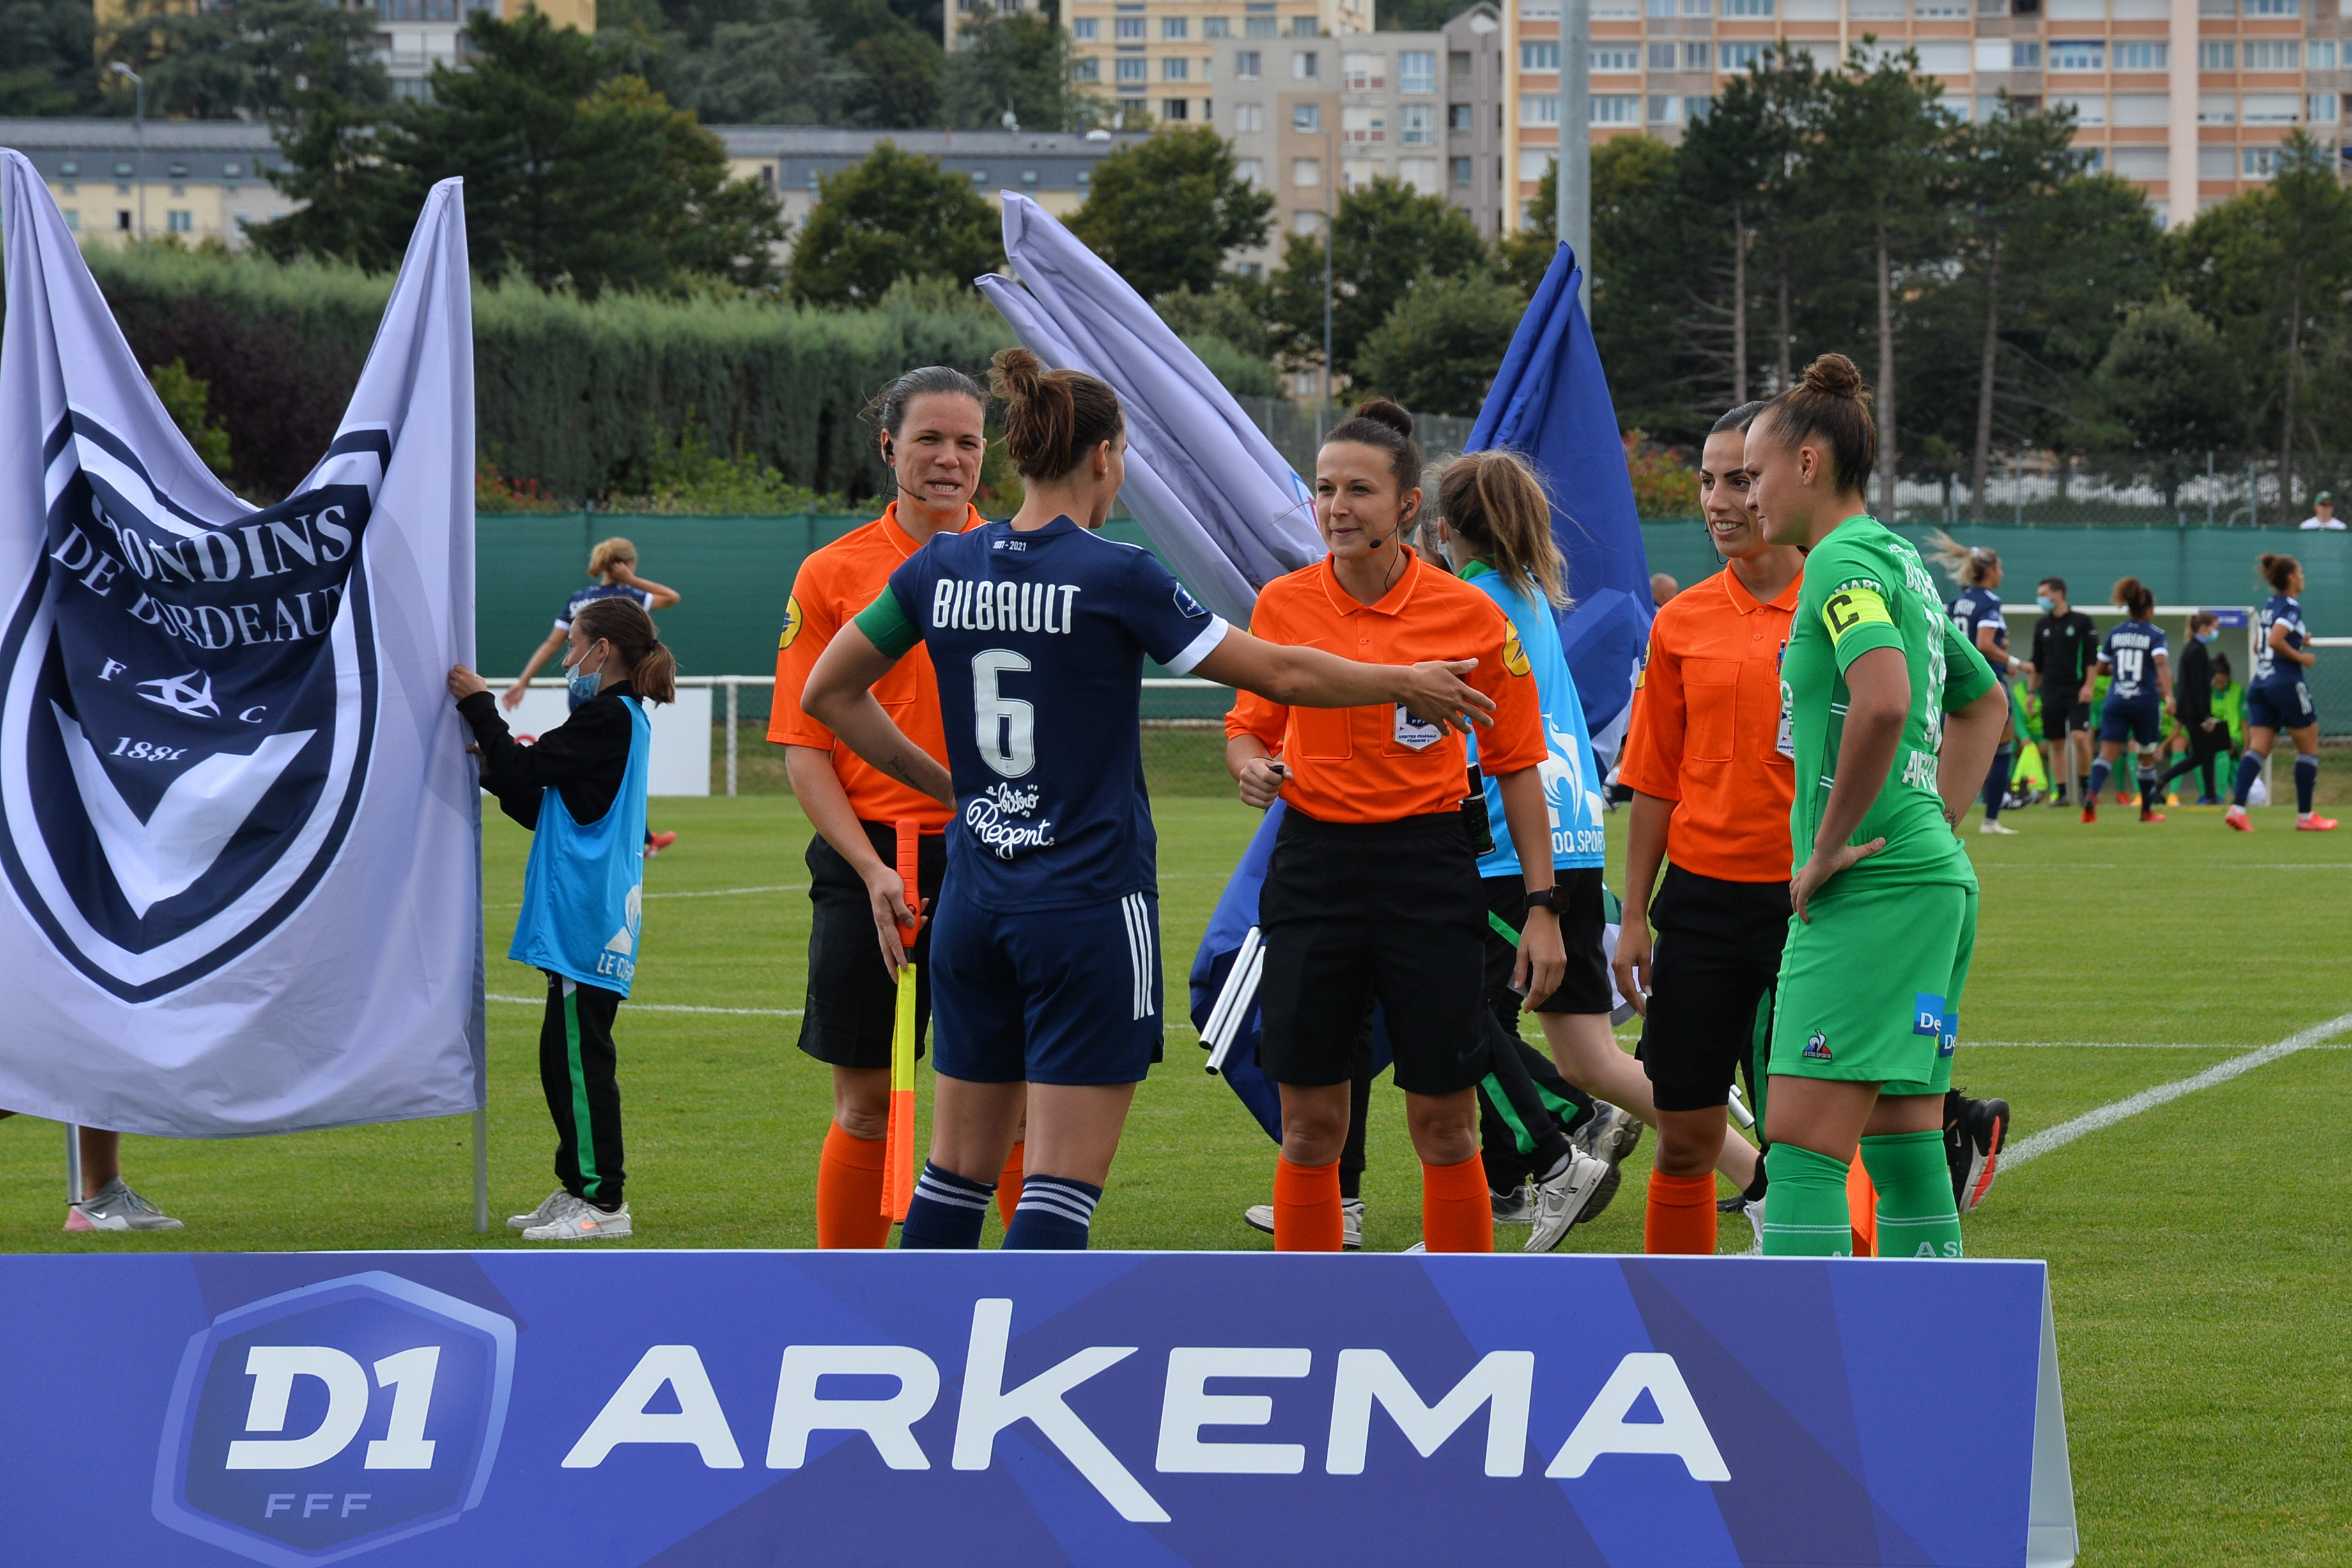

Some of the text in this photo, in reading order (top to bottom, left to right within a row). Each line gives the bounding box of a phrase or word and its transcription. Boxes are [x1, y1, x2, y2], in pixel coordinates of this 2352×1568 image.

[91, 494, 352, 583] ONDINS
[50, 523, 344, 649] DE ORDEAU
[933, 578, 1081, 634] BILBAULT
[1827, 594, 1860, 634] C
[98, 657, 267, 723] F C
[2116, 648, 2144, 682] 14
[971, 649, 1035, 779] 6
[966, 797, 1051, 860] Régent
[1552, 830, 1605, 854] OQ SPOR
[597, 953, 616, 975] LE
[1914, 1241, 1963, 1258] AS
[226, 1346, 440, 1470] D1
[561, 1298, 1732, 1523] ARKEMA
[265, 1493, 371, 1518] FFF
